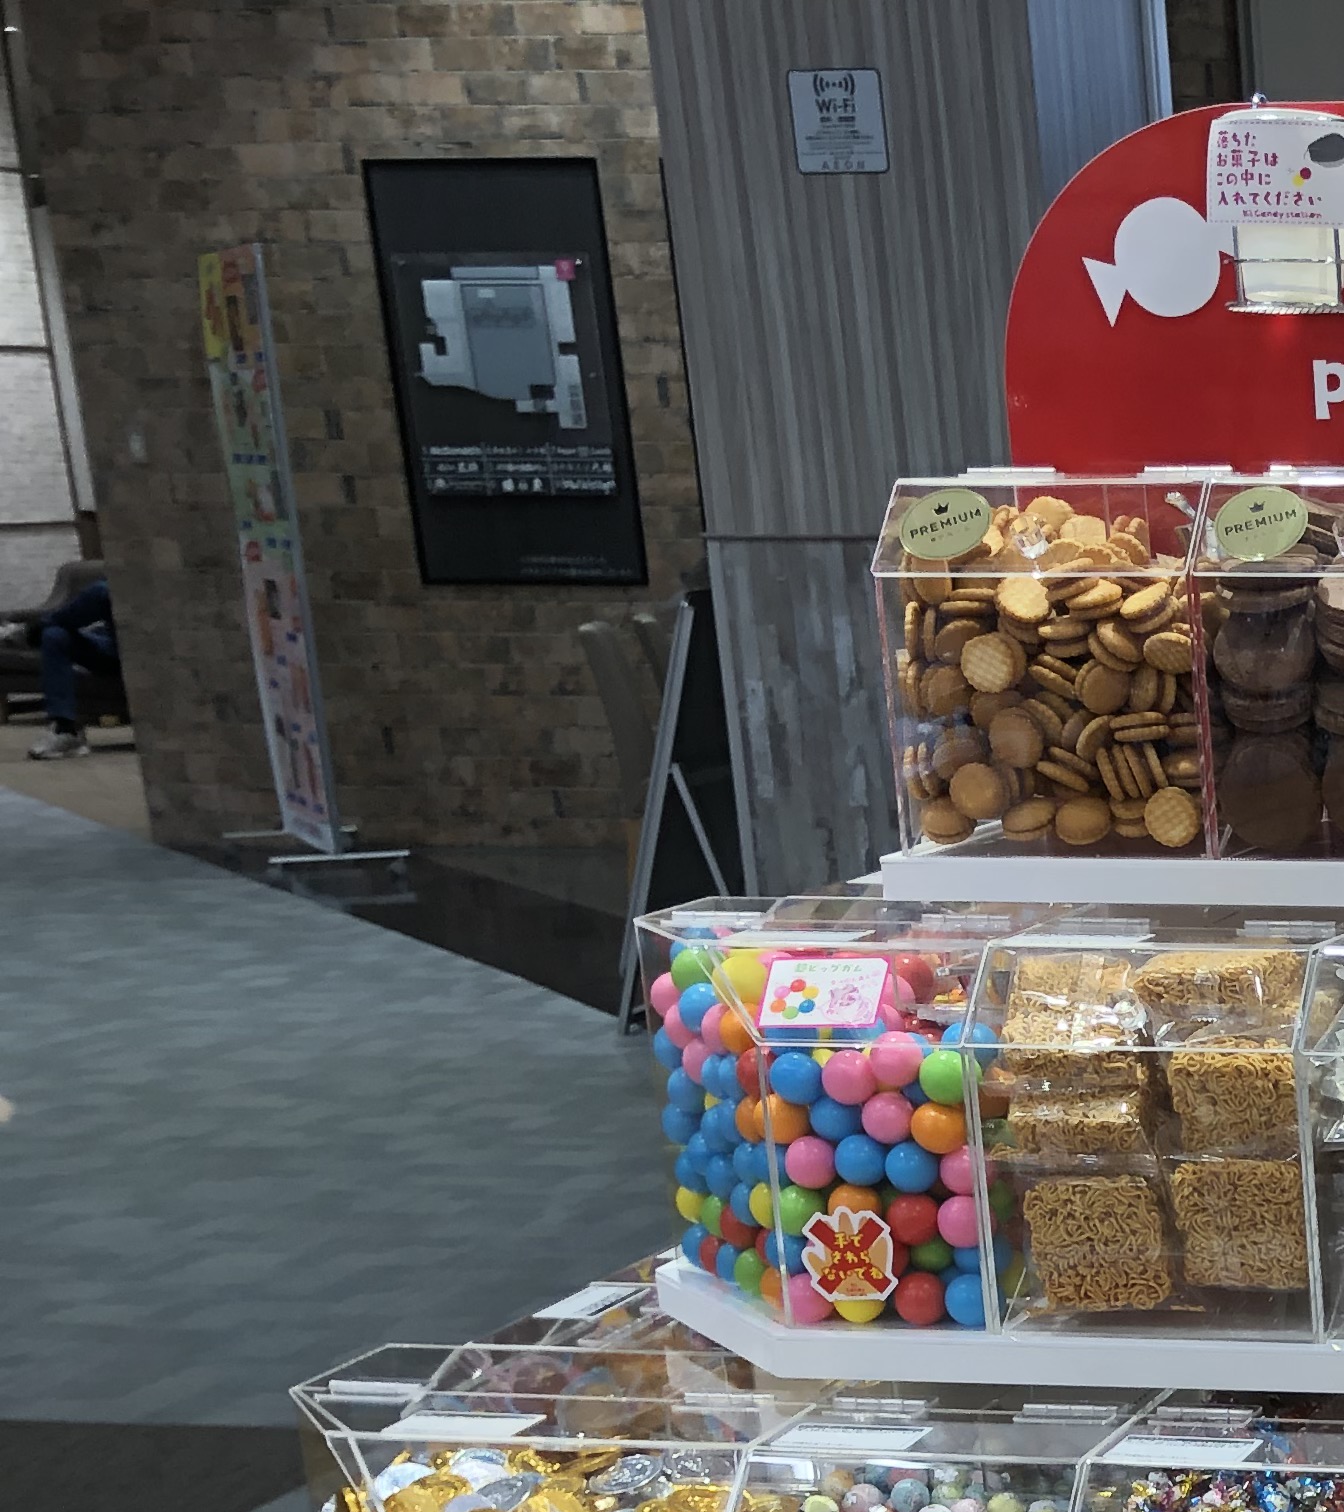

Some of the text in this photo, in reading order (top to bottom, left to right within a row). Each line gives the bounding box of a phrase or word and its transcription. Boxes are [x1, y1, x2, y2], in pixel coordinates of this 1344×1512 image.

[815, 97, 856, 114] Wi-Fi
[1216, 130, 1257, 149] 落ちた
[1216, 149, 1279, 168] お菓子は
[1216, 168, 1272, 187] この中に
[1217, 190, 1323, 207] 入れてください
[1254, 210, 1284, 219] Candy
[909, 507, 983, 540] PREMIUM
[1223, 507, 1299, 543] PREMIUM
[833, 1232, 864, 1249] 手で
[831, 1250, 871, 1265] さわら
[822, 1266, 884, 1281] ないでね
